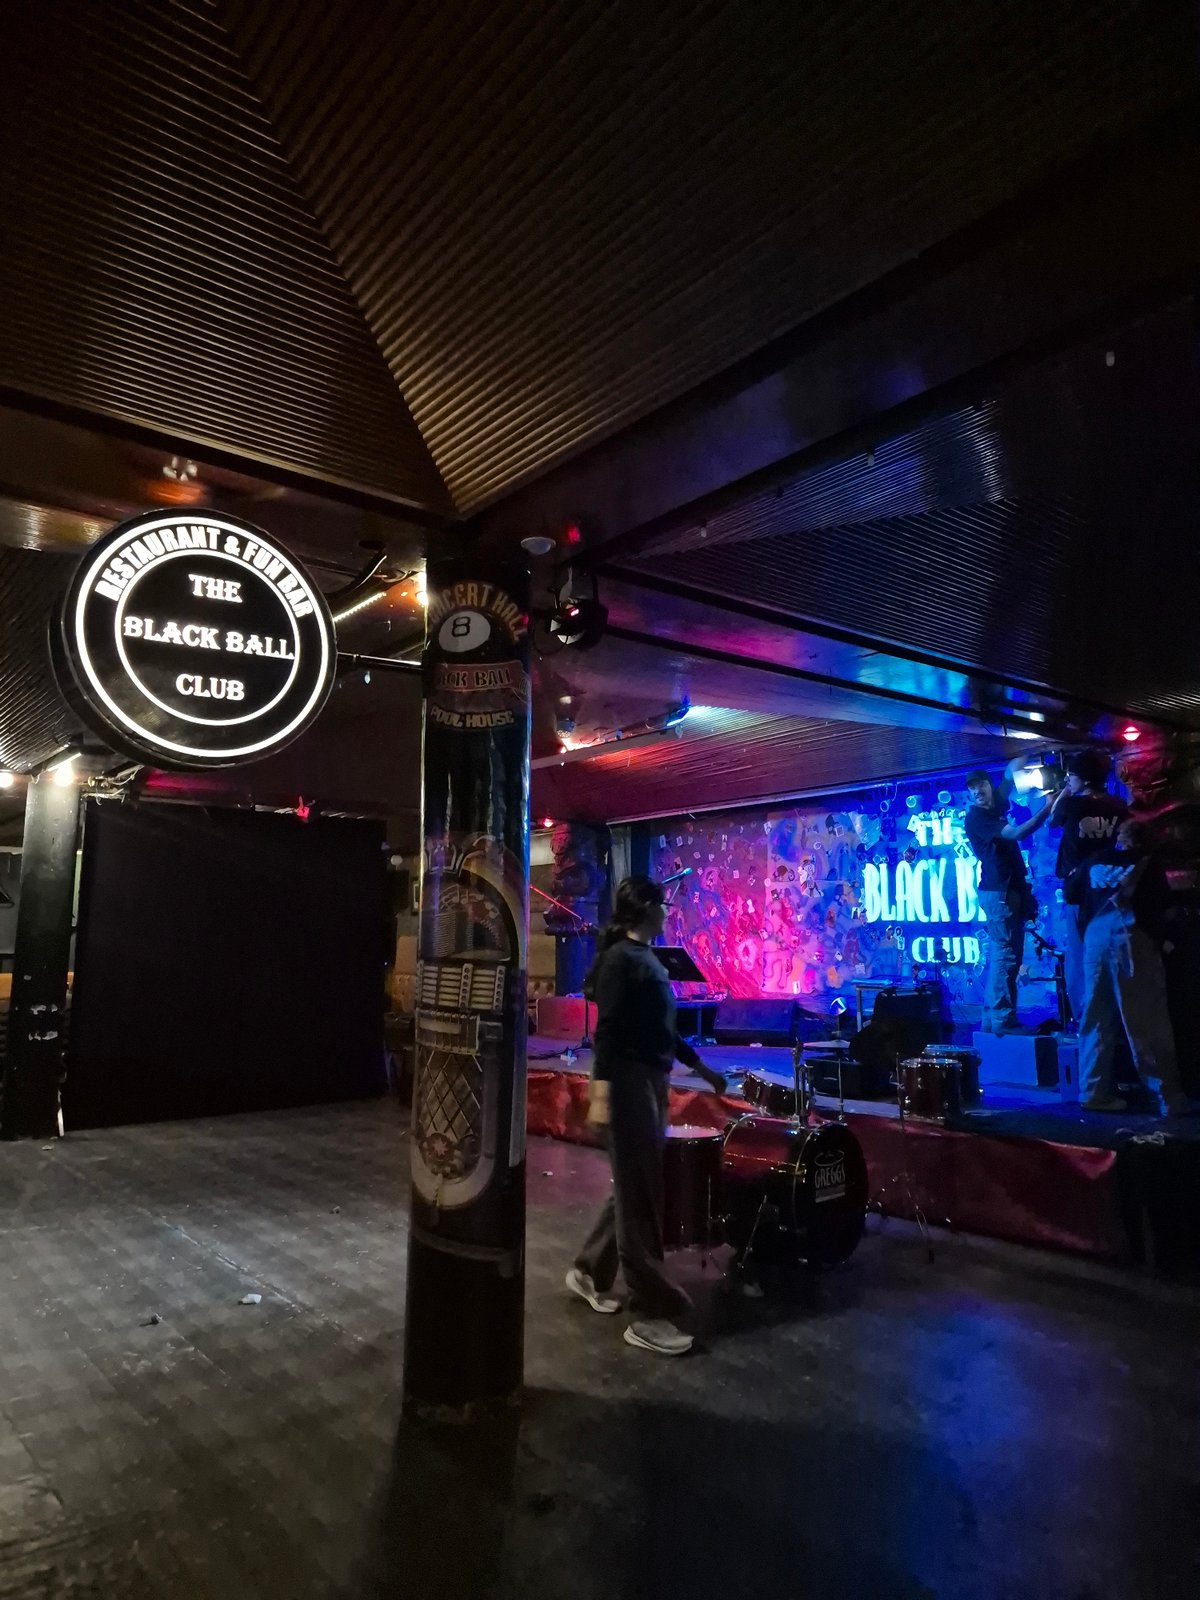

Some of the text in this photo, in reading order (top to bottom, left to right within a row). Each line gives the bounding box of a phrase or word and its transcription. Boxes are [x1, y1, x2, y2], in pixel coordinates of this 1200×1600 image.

[95, 526, 314, 618] RESTAURANT & FUN BAR
[188, 573, 243, 603] THE
[123, 616, 295, 660] BLACK BALL
[452, 616, 471, 637] 8
[175, 673, 245, 701] CLUB
[430, 705, 515, 728] POOL HOUSE
[863, 857, 951, 923] BLACK
[911, 936, 981, 964] CLUB
